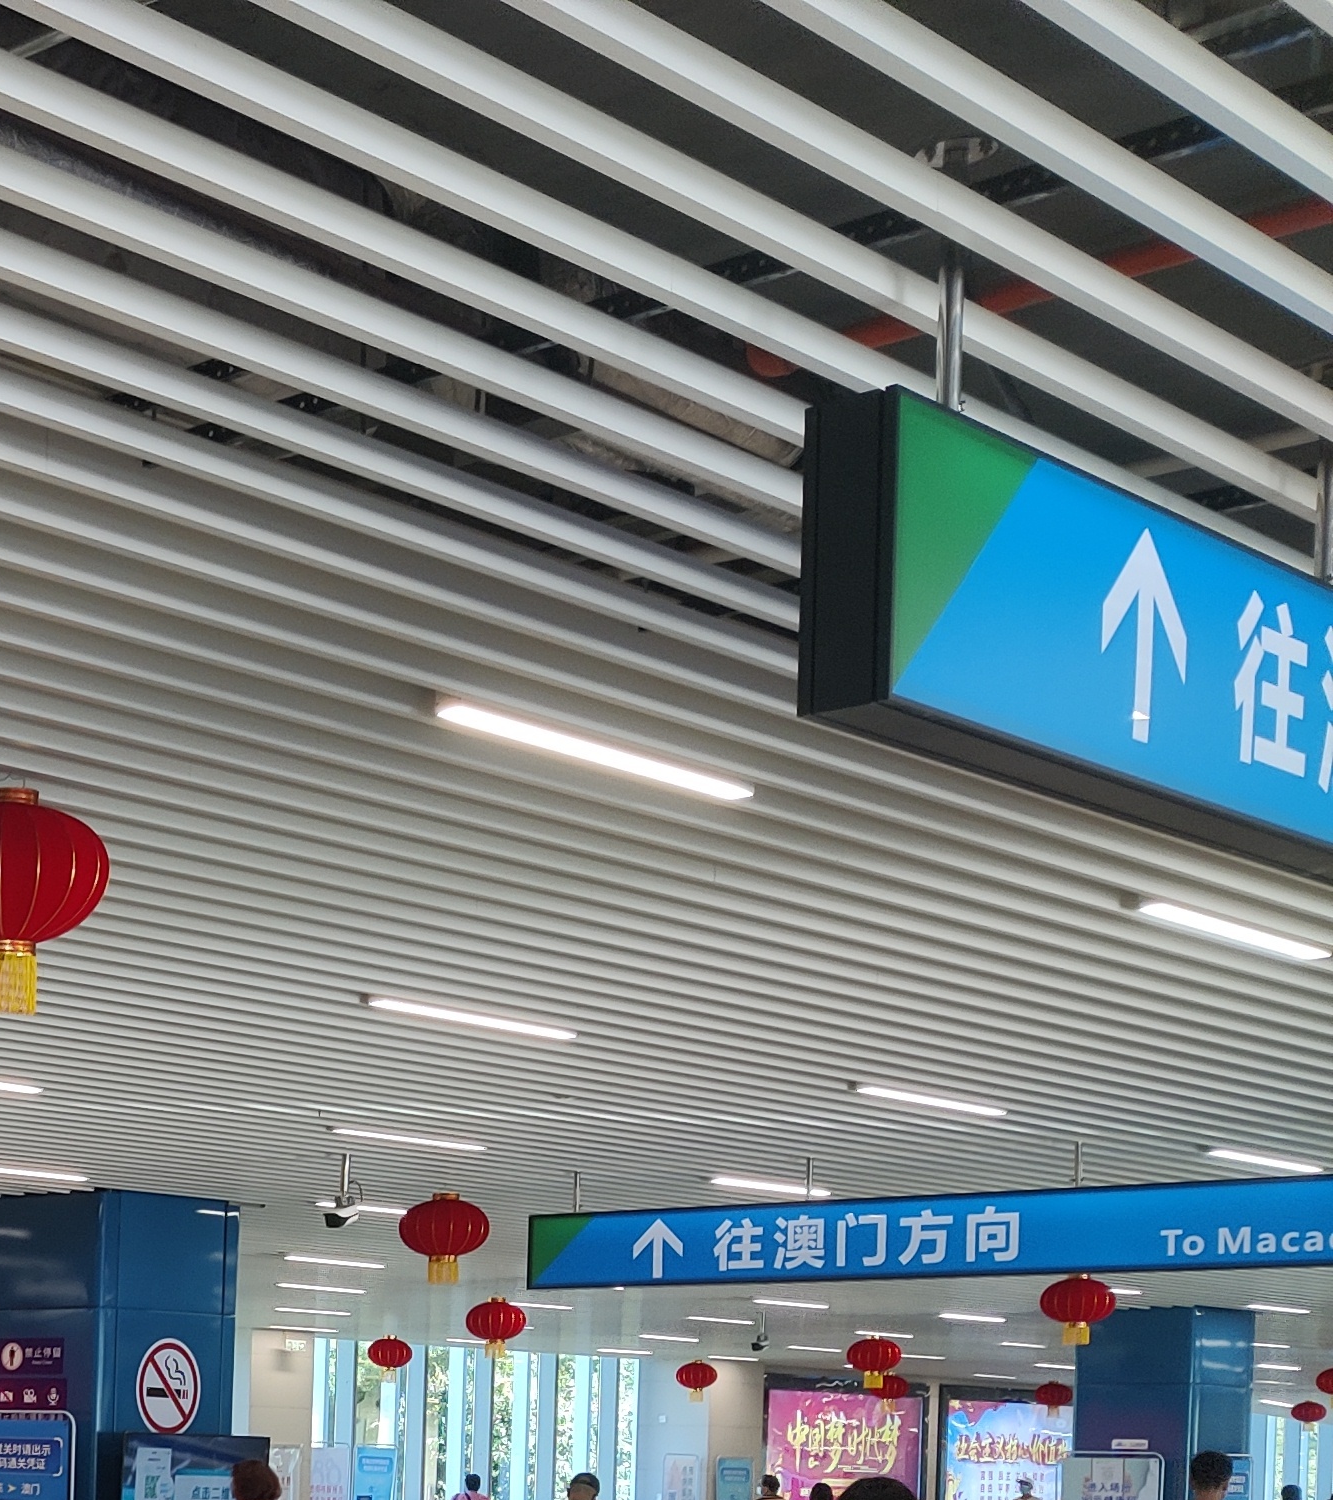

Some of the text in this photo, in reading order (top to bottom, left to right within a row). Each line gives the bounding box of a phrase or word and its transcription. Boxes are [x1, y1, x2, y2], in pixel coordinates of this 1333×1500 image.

[1234, 589, 1333, 794] 往
[714, 1205, 1021, 1272] 往澳门方向
[1160, 1226, 1333, 1256] To Maca
[20, 1482, 41, 1496] 澳门
[191, 1485, 236, 1500] 点击二维
